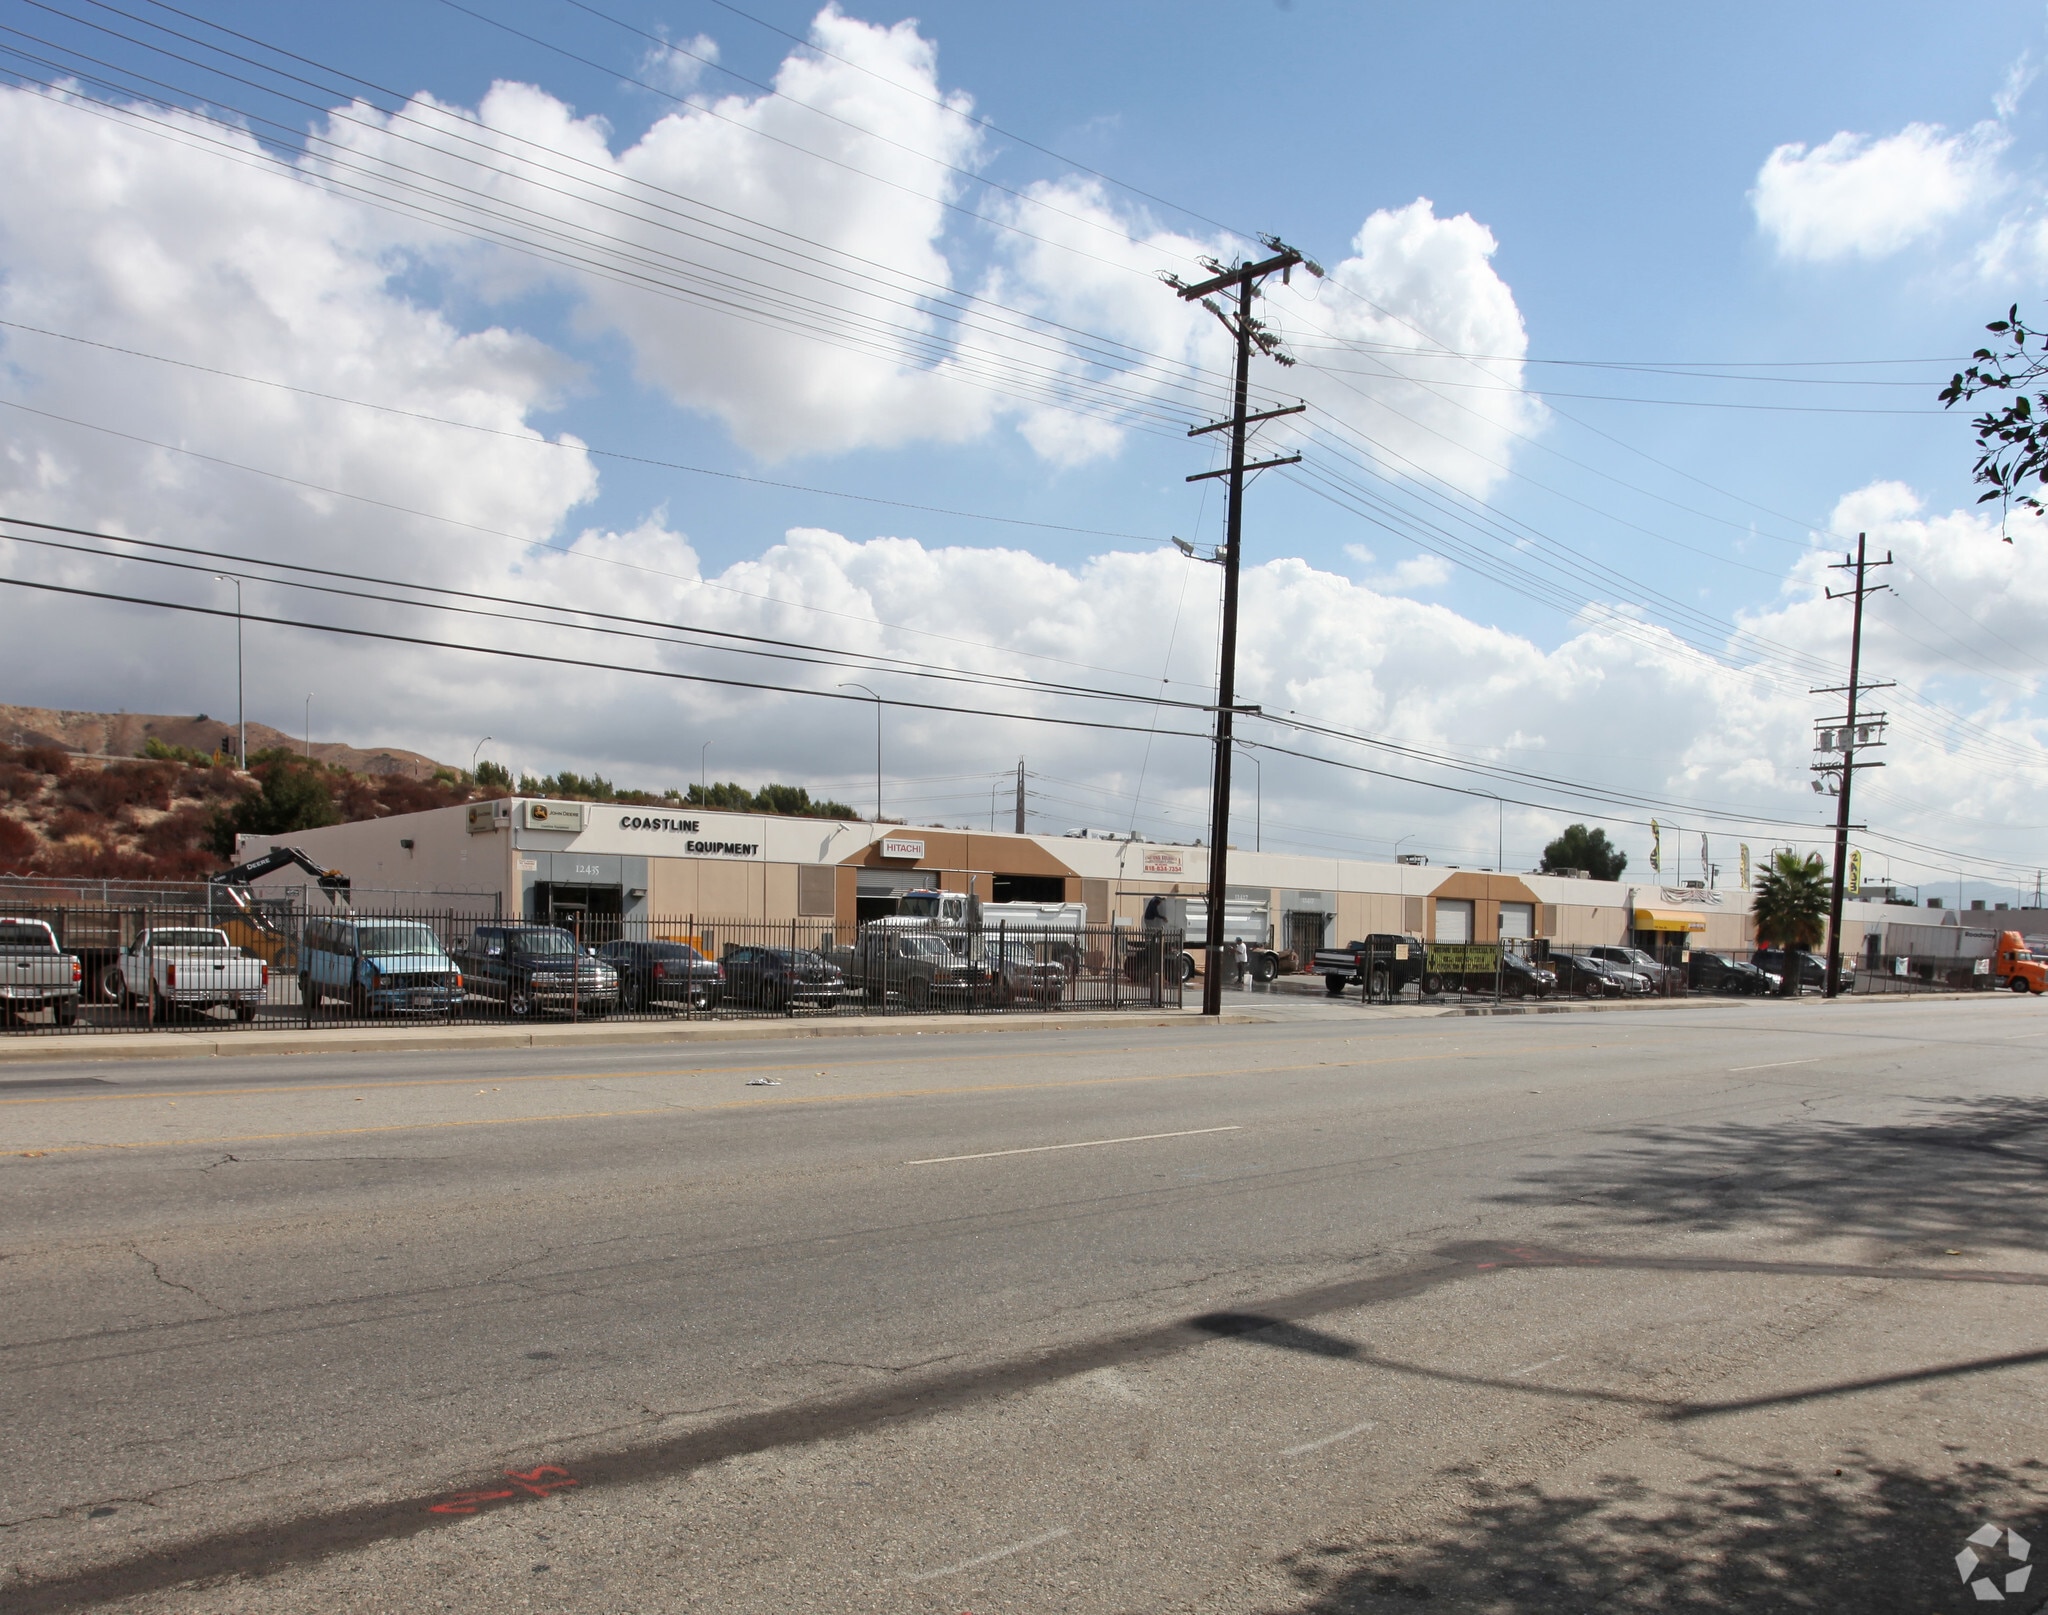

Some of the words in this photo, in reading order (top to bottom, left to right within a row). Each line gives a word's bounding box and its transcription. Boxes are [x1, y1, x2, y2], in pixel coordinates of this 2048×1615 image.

[621, 816, 700, 832] COASTLINE
[686, 840, 759, 855] EQUIPMENT
[886, 843, 921, 853] HITACHI
[246, 857, 271, 870] DEERE
[575, 864, 600, 875] 12435
[1964, 931, 1996, 939] Roadway
